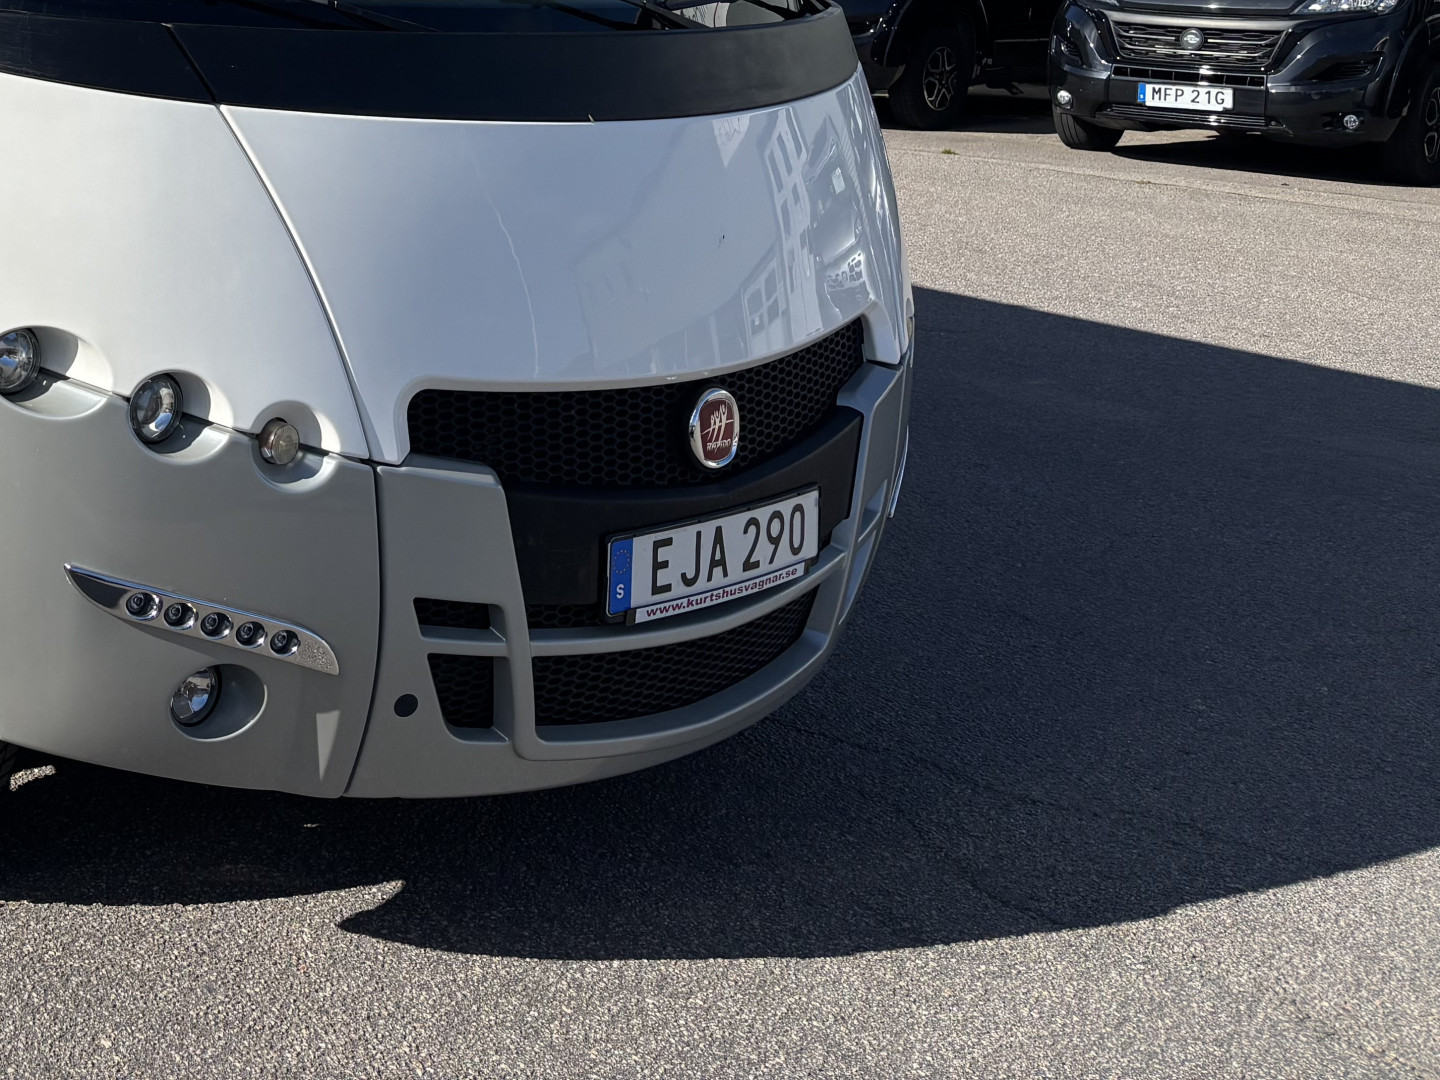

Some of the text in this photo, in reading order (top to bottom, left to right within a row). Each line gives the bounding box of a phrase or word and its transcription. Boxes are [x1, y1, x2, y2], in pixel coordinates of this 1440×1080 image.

[1151, 86, 1185, 103] MFP
[1190, 89, 1225, 105] 21G
[650, 503, 806, 596] EJA 290
[615, 583, 625, 600] S
[645, 566, 799, 618] www.kurtshusvagnar.se
